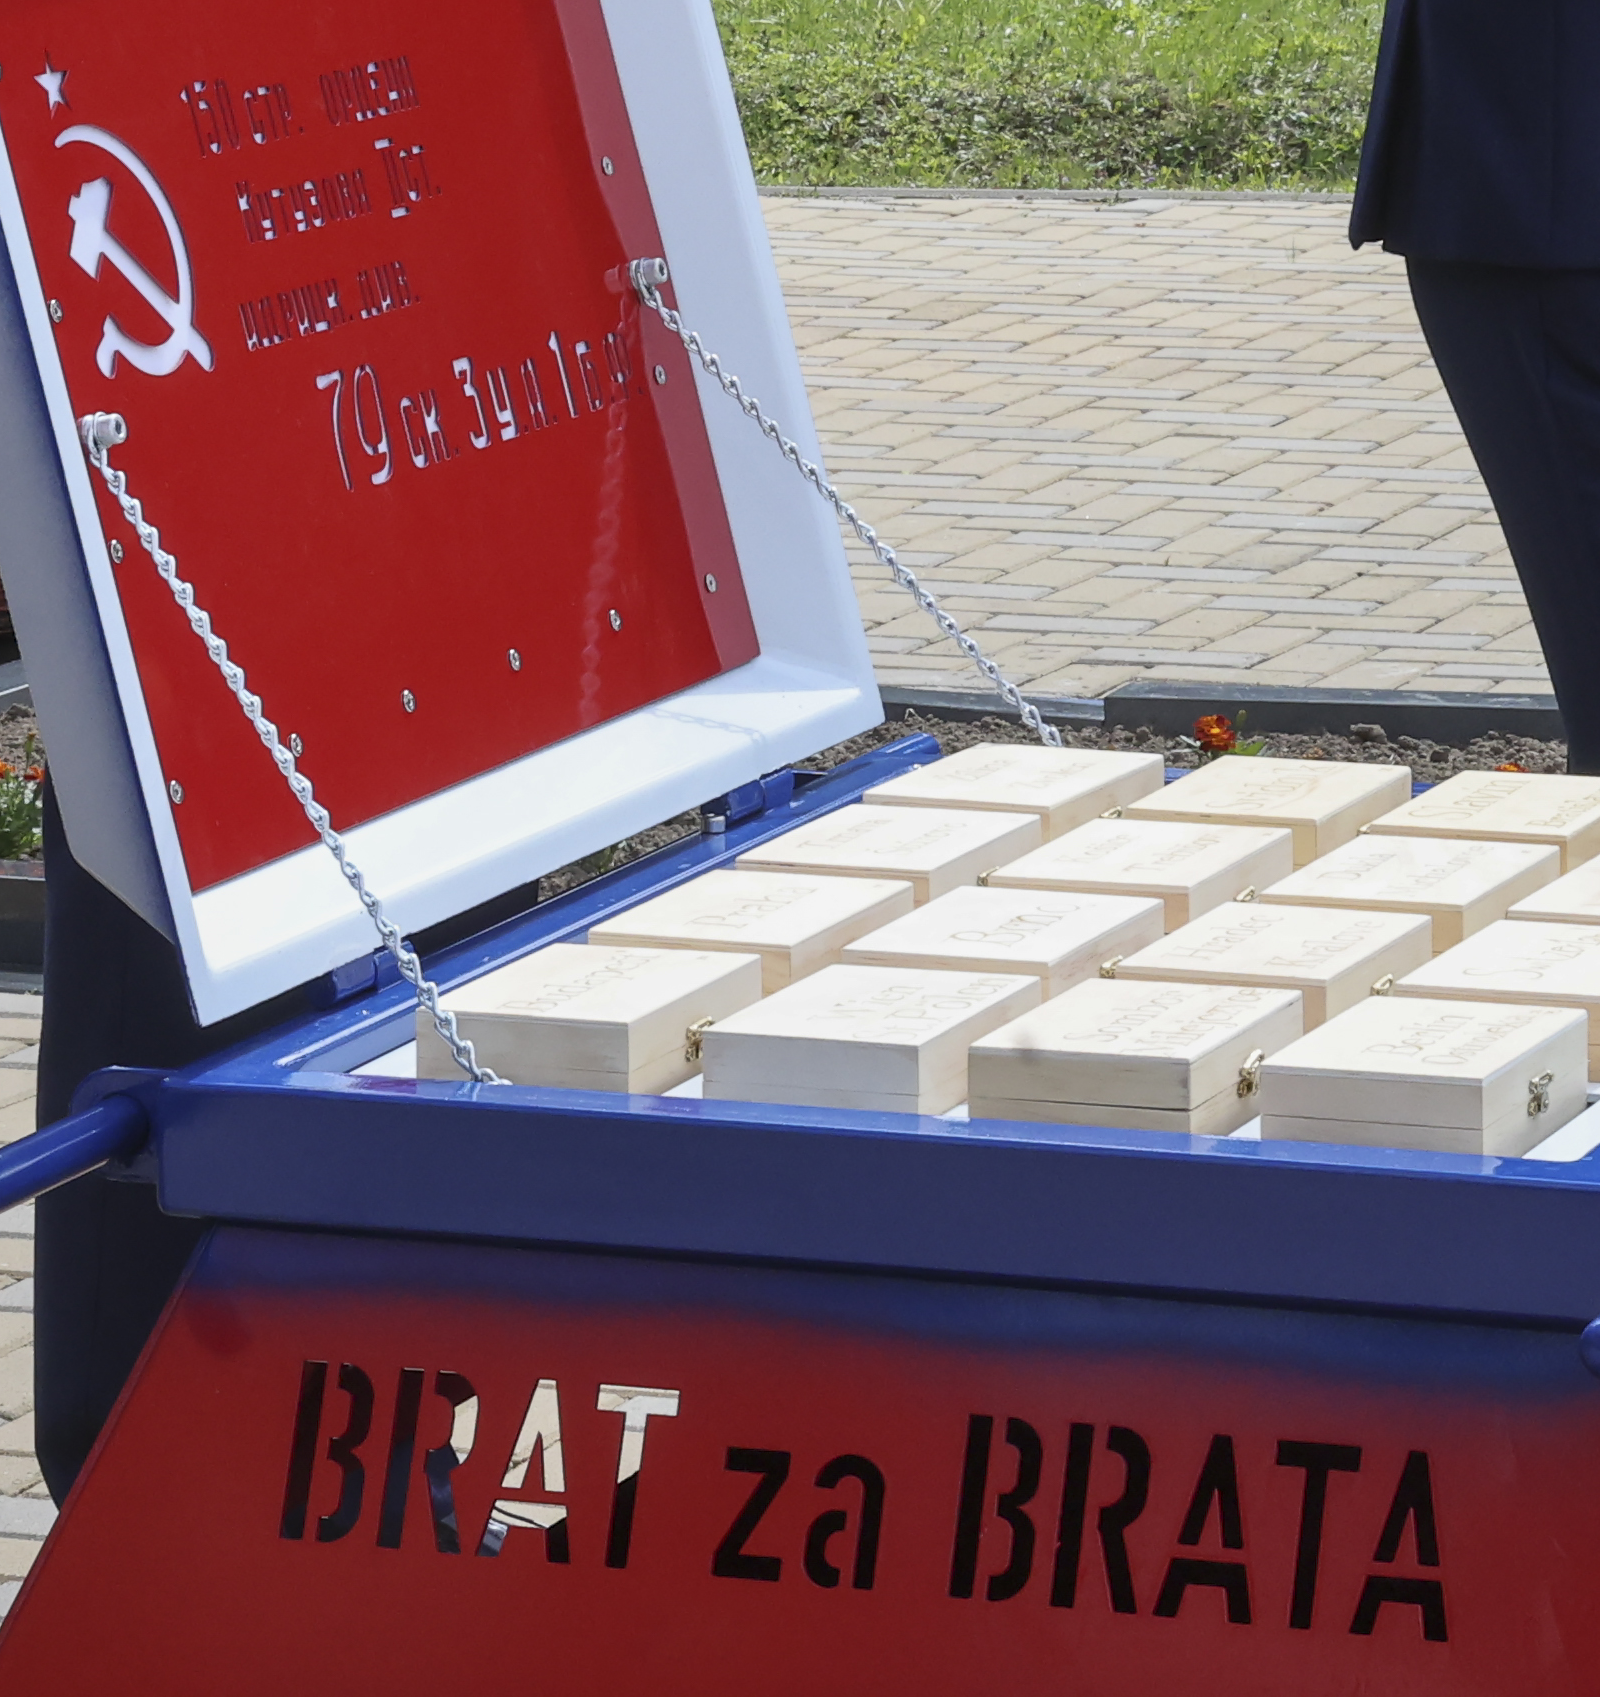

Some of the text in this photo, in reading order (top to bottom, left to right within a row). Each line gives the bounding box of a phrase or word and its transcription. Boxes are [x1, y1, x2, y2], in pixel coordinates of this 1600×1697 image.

[180, 78, 241, 159] 150
[315, 363, 393, 492] 79
[683, 887, 819, 929] Praha
[941, 903, 1081, 948] Brno
[1161, 914, 1285, 961] Hradec
[1063, 990, 1194, 1042] Sombor
[1361, 1015, 1475, 1057] Berlin
[280, 1360, 1449, 1642] BRAT za BRATA
